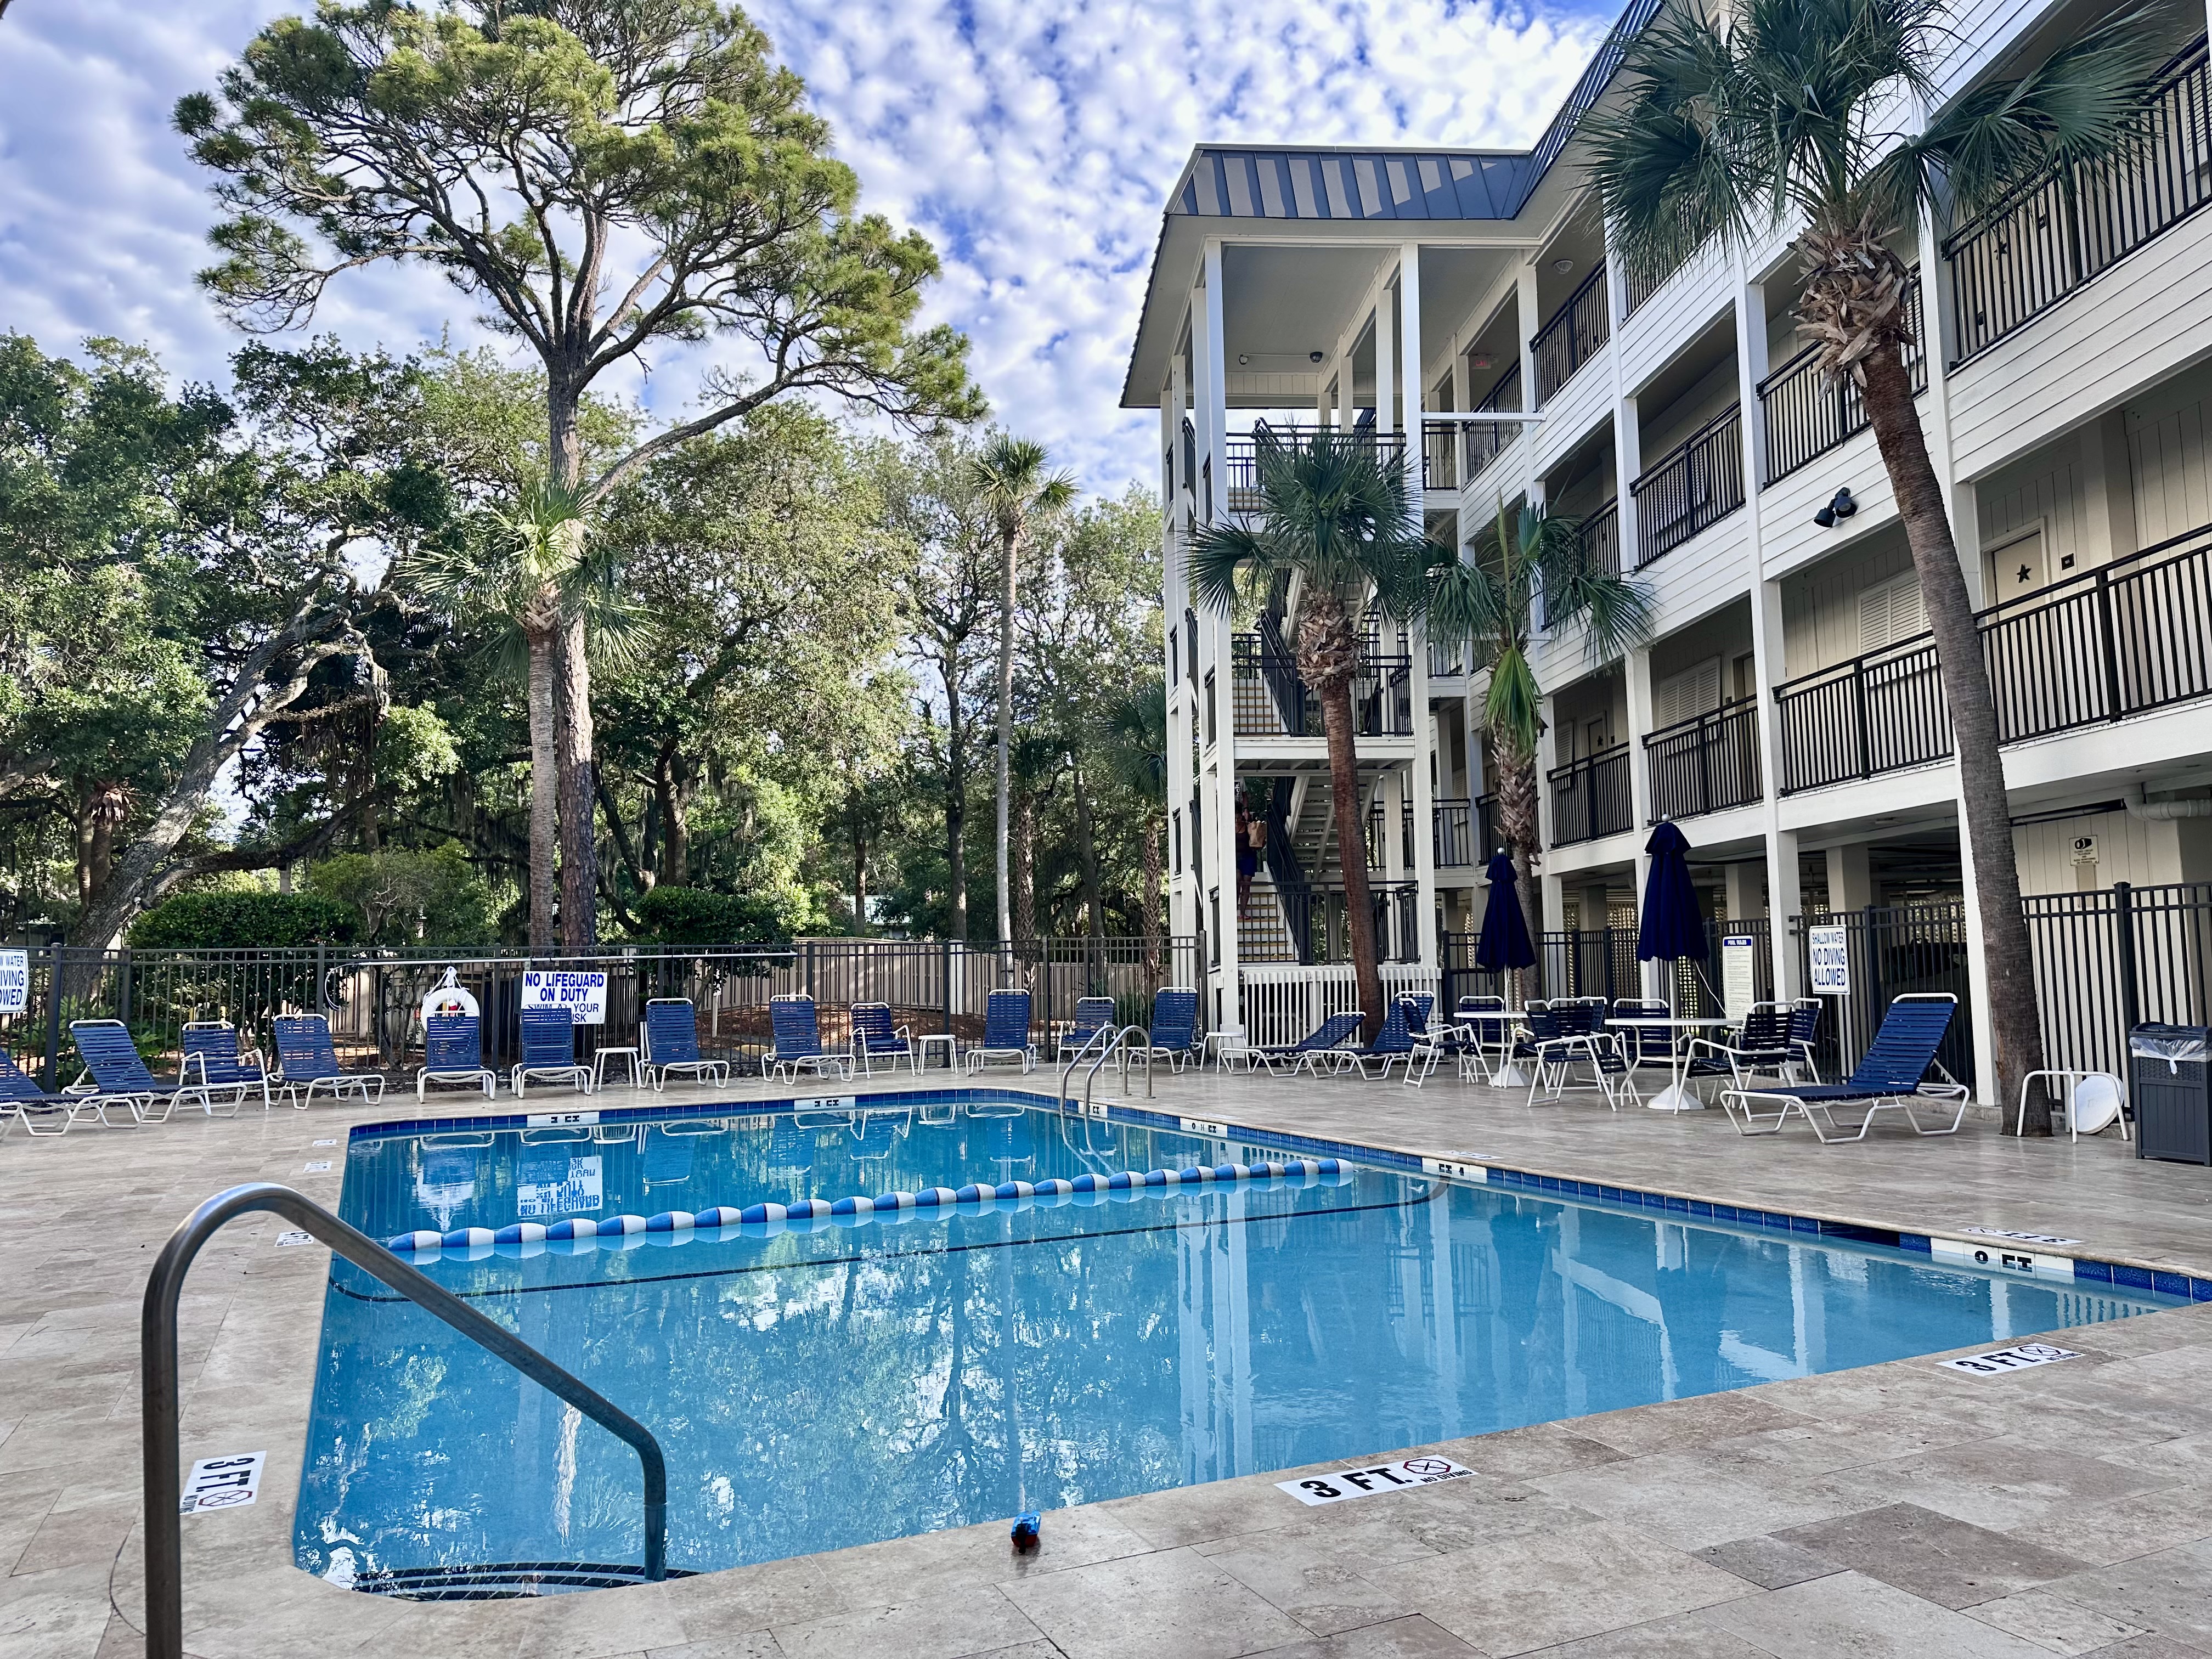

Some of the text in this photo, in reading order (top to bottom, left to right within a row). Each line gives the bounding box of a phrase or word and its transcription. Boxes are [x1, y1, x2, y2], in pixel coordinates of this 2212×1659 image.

[1813, 932, 1844, 944] SHALLOW WATER
[5, 956, 24, 967] WATER
[1813, 947, 1845, 966] NO DIVING
[526, 973, 604, 988] NO LIFEGUARD
[1815, 968, 1845, 986] ALLOWED
[540, 988, 589, 1002] ON DUTY
[573, 1003, 599, 1013] YOUR
[572, 1013, 587, 1023] ISK
[1955, 1361, 1997, 1372] 3
[195, 1458, 256, 1492] 3 FT.
[1436, 1470, 1473, 1480] DIVING
[1300, 1468, 1414, 1498] 3 FT.
